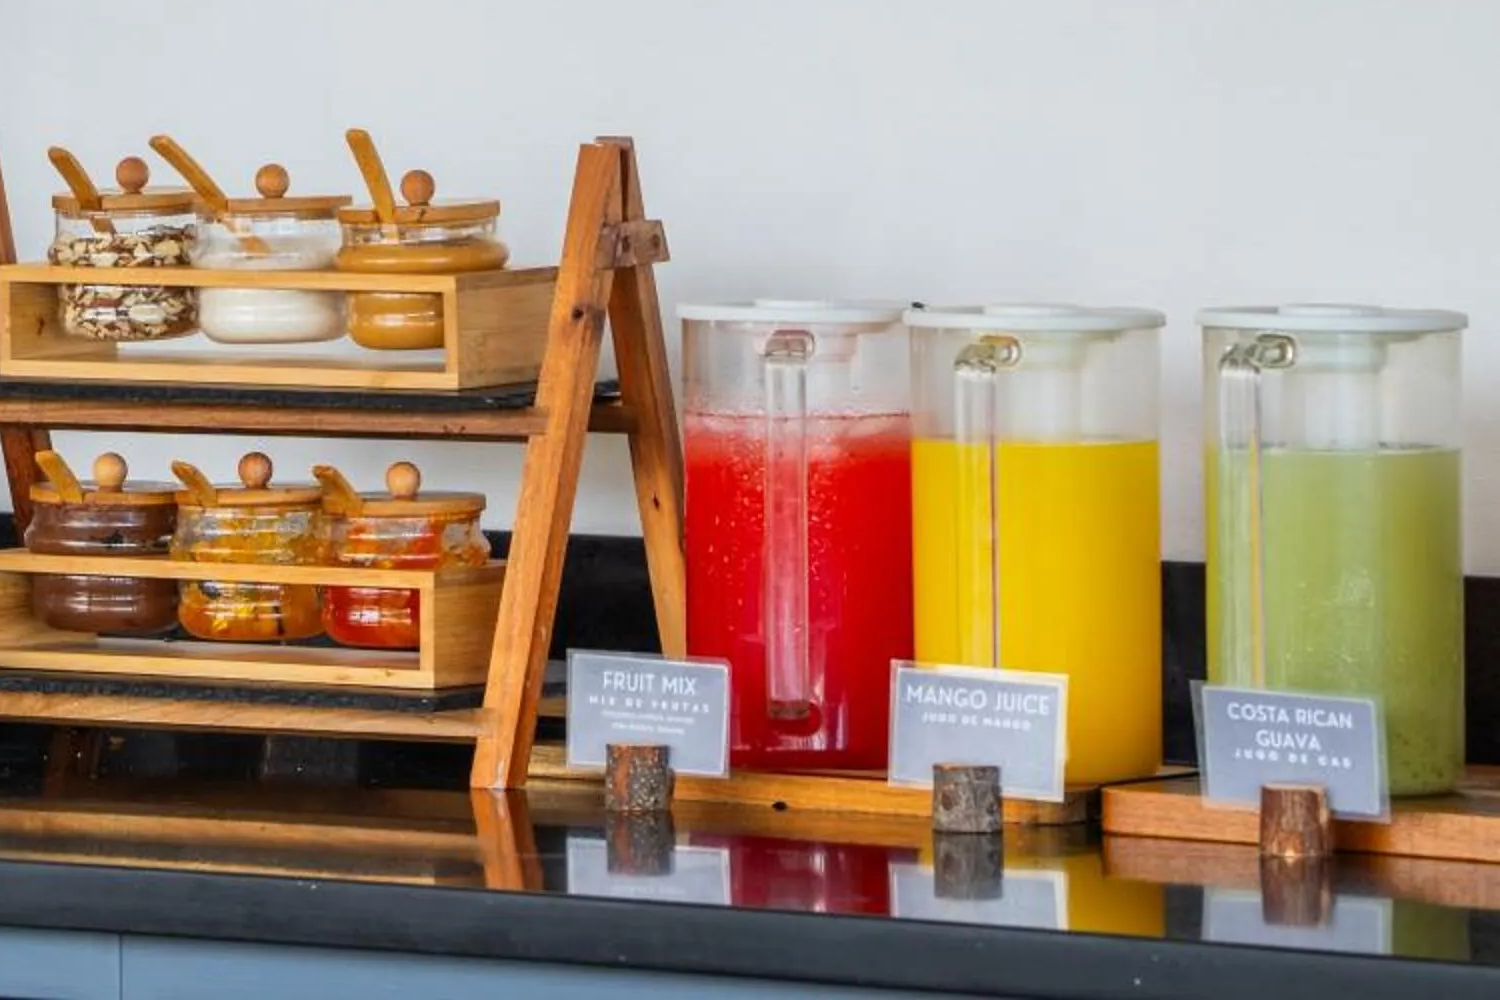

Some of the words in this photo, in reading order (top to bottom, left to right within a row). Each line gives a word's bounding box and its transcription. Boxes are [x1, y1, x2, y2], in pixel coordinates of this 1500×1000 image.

[602, 670, 655, 692] FRUIT
[661, 676, 697, 696] MIX
[905, 684, 988, 710] MANGO
[995, 692, 1049, 716] JUICE
[1227, 702, 1290, 724] COSTA
[1295, 709, 1354, 729] RICAN
[1255, 730, 1322, 751] GUAVA
